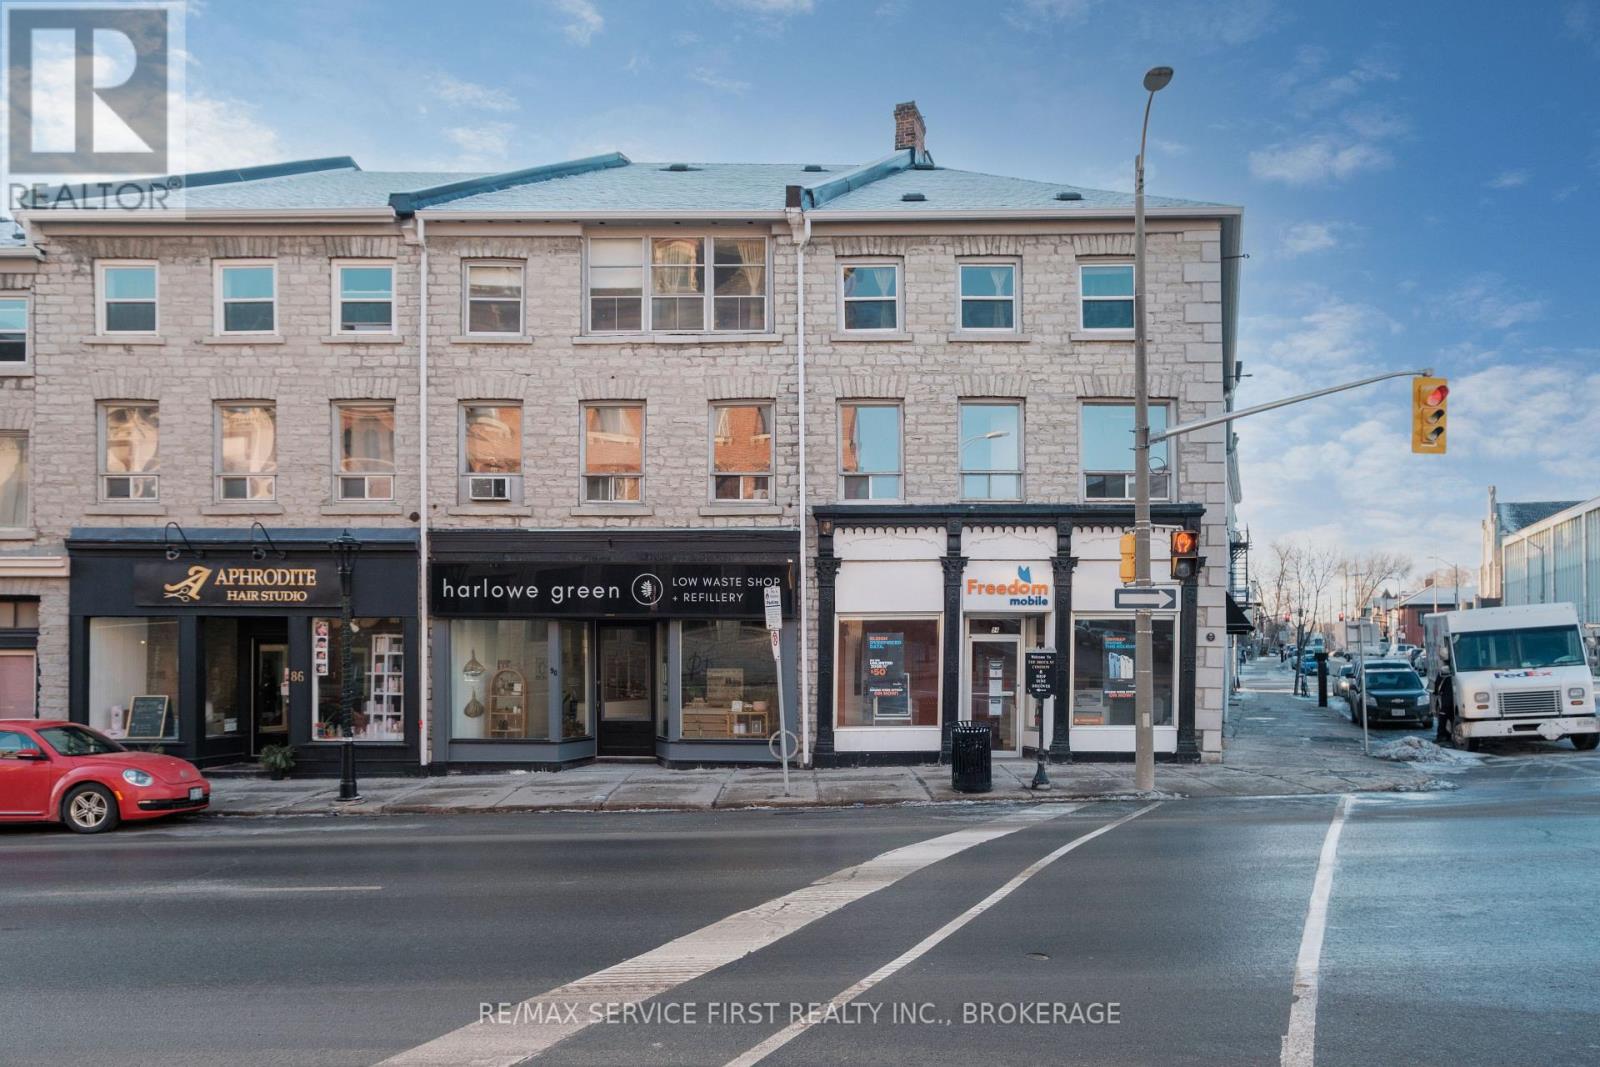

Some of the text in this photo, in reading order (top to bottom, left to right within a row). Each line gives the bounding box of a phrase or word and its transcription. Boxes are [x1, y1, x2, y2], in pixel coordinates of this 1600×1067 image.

[214, 568, 317, 586] APHRODITE
[672, 577, 780, 587] LOW WASTE SHOP
[443, 578, 620, 604] harlowe green
[967, 578, 1049, 595] Freedom
[227, 590, 307, 602] HAIR STUDIO
[683, 592, 744, 602] REFILLERY
[1009, 596, 1049, 606] mobile
[290, 671, 304, 682] 86
[1494, 671, 1552, 679] FedEx
